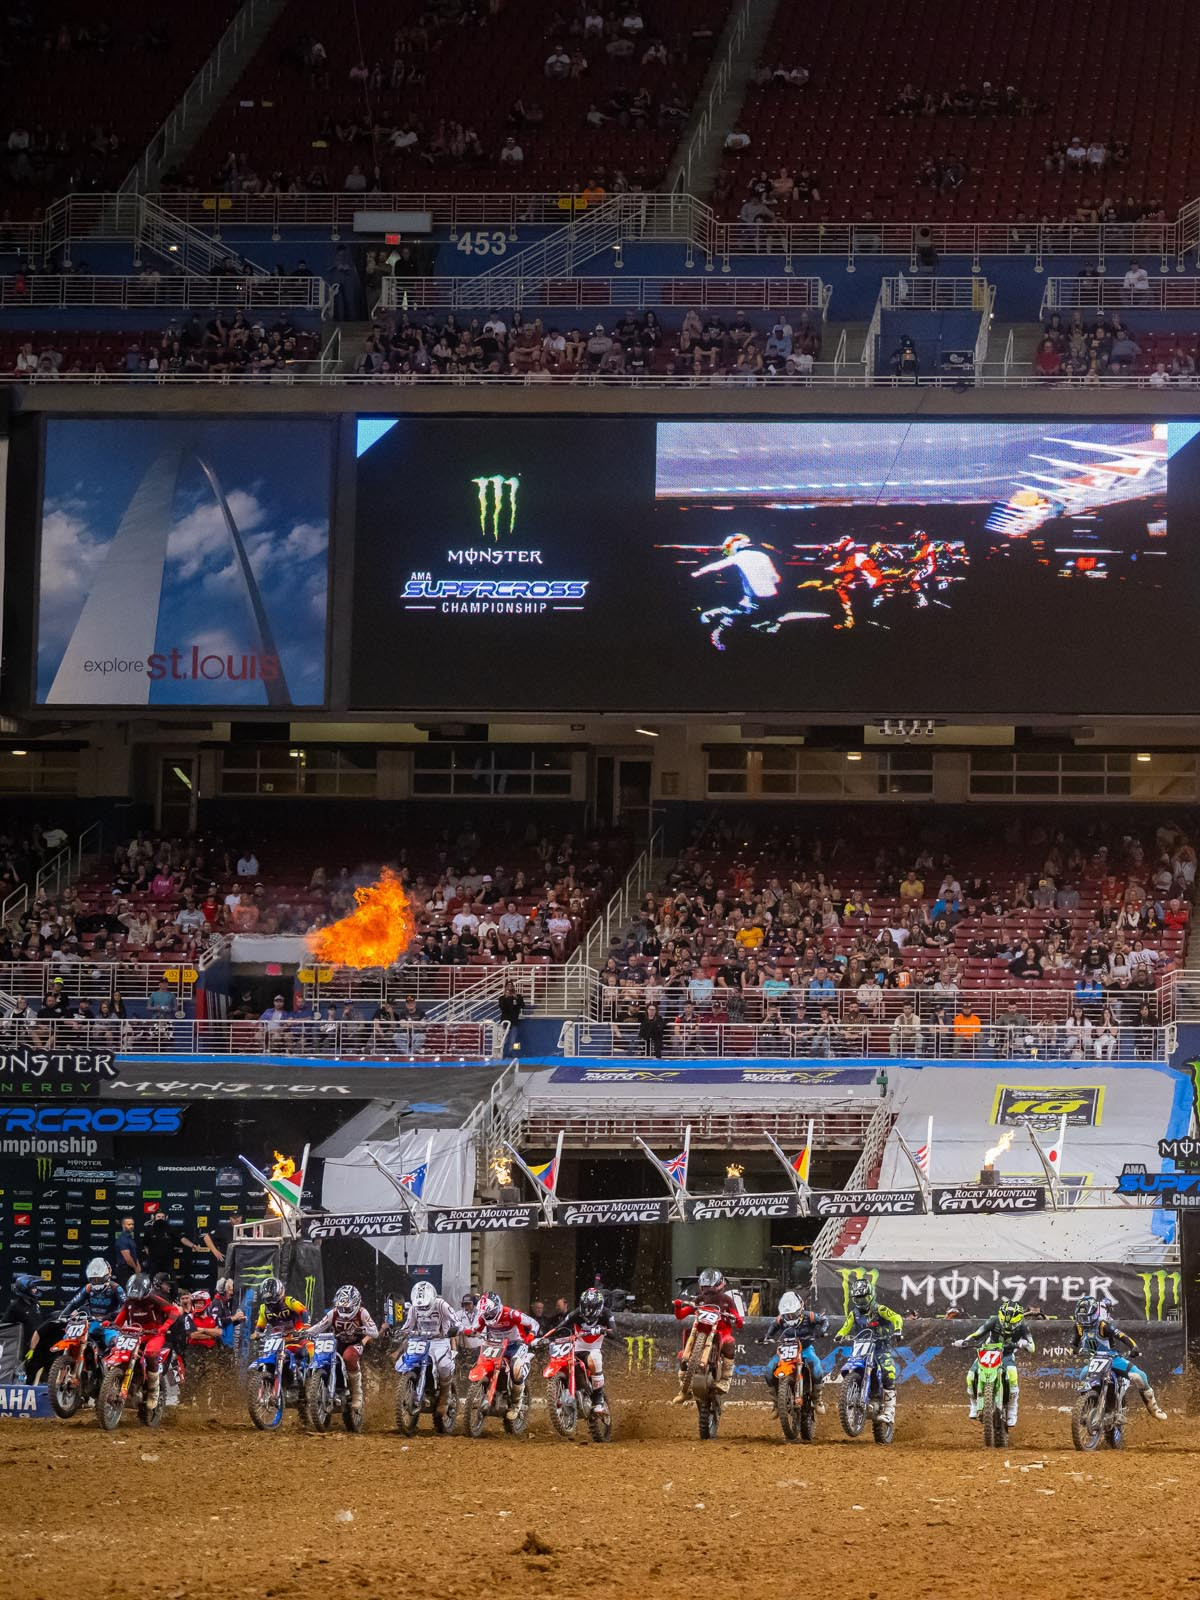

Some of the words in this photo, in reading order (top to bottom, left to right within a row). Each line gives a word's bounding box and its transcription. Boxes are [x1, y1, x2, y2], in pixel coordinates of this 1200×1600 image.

[457, 232, 507, 255] 453
[448, 548, 543, 564] MONSTER
[411, 572, 431, 581] AMA
[401, 581, 589, 598] SUPERCROSS
[442, 603, 547, 613] CHAMPIONSHIP
[84, 657, 143, 675] explore
[0, 1051, 116, 1076] NSTER
[1, 1083, 91, 1092] NERGY
[1124, 1165, 1146, 1174] AMA
[834, 1195, 863, 1203] ROCKY
[865, 1193, 915, 1201] MOUNTAIN
[986, 1189, 1037, 1197] MOUNTAIN
[581, 1204, 609, 1212] ROCKY
[611, 1202, 660, 1211] MOUNTAIN
[708, 1199, 737, 1207] ROCKY
[738, 1196, 789, 1205] MOUNTAIN
[323, 1217, 350, 1225] ROCKY
[353, 1215, 402, 1224] MOUNTAIN
[451, 1210, 478, 1218] ROCKY
[480, 1209, 530, 1217] MOUNTAIN
[901, 1270, 1119, 1307] MONSTER
[697, 1310, 719, 1323] 78
[116, 1336, 137, 1350] 245
[263, 1339, 283, 1352] 91
[315, 1340, 335, 1353] 36
[407, 1341, 426, 1354] 26
[482, 1346, 500, 1358] 41
[781, 1345, 799, 1359] 35
[1088, 1358, 1109, 1372] 57
